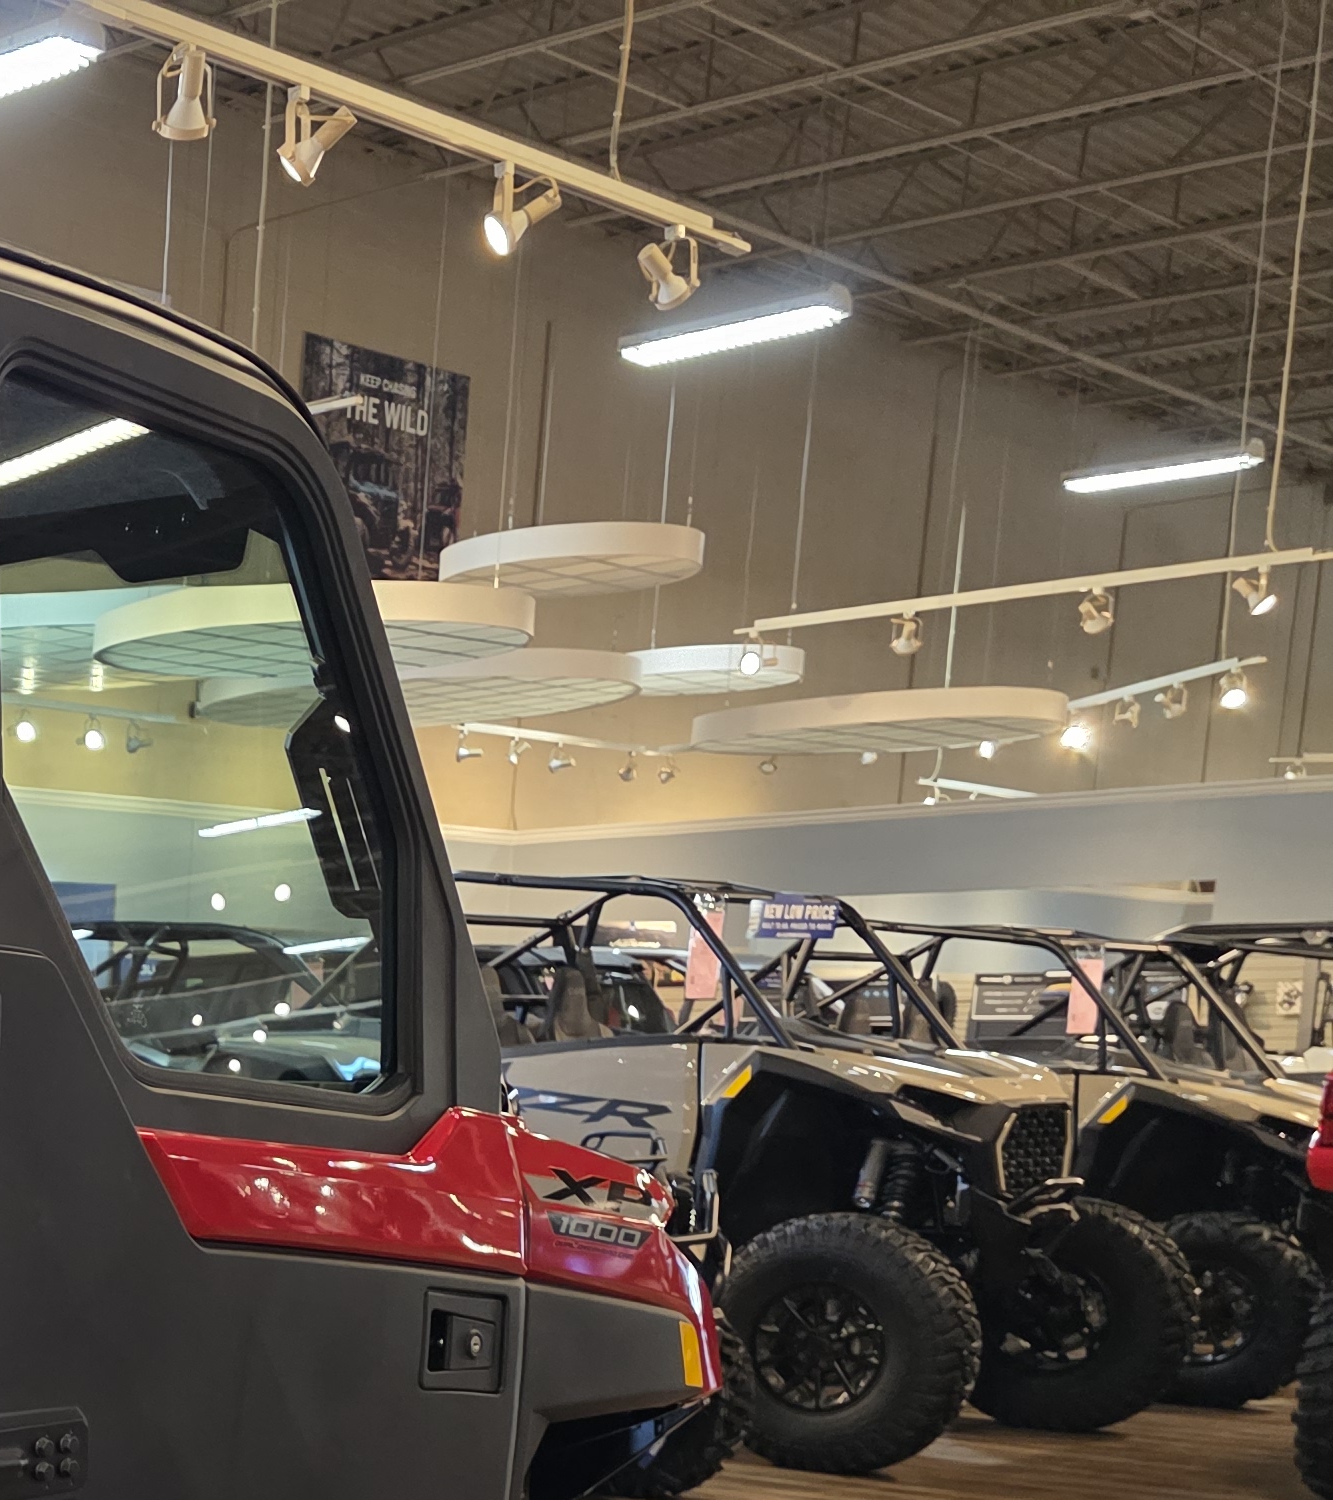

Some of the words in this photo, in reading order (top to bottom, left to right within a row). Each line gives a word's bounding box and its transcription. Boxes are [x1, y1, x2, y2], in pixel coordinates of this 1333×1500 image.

[384, 400, 429, 436] WILD
[543, 1167, 653, 1212] XP
[559, 1216, 642, 1247] 1000
